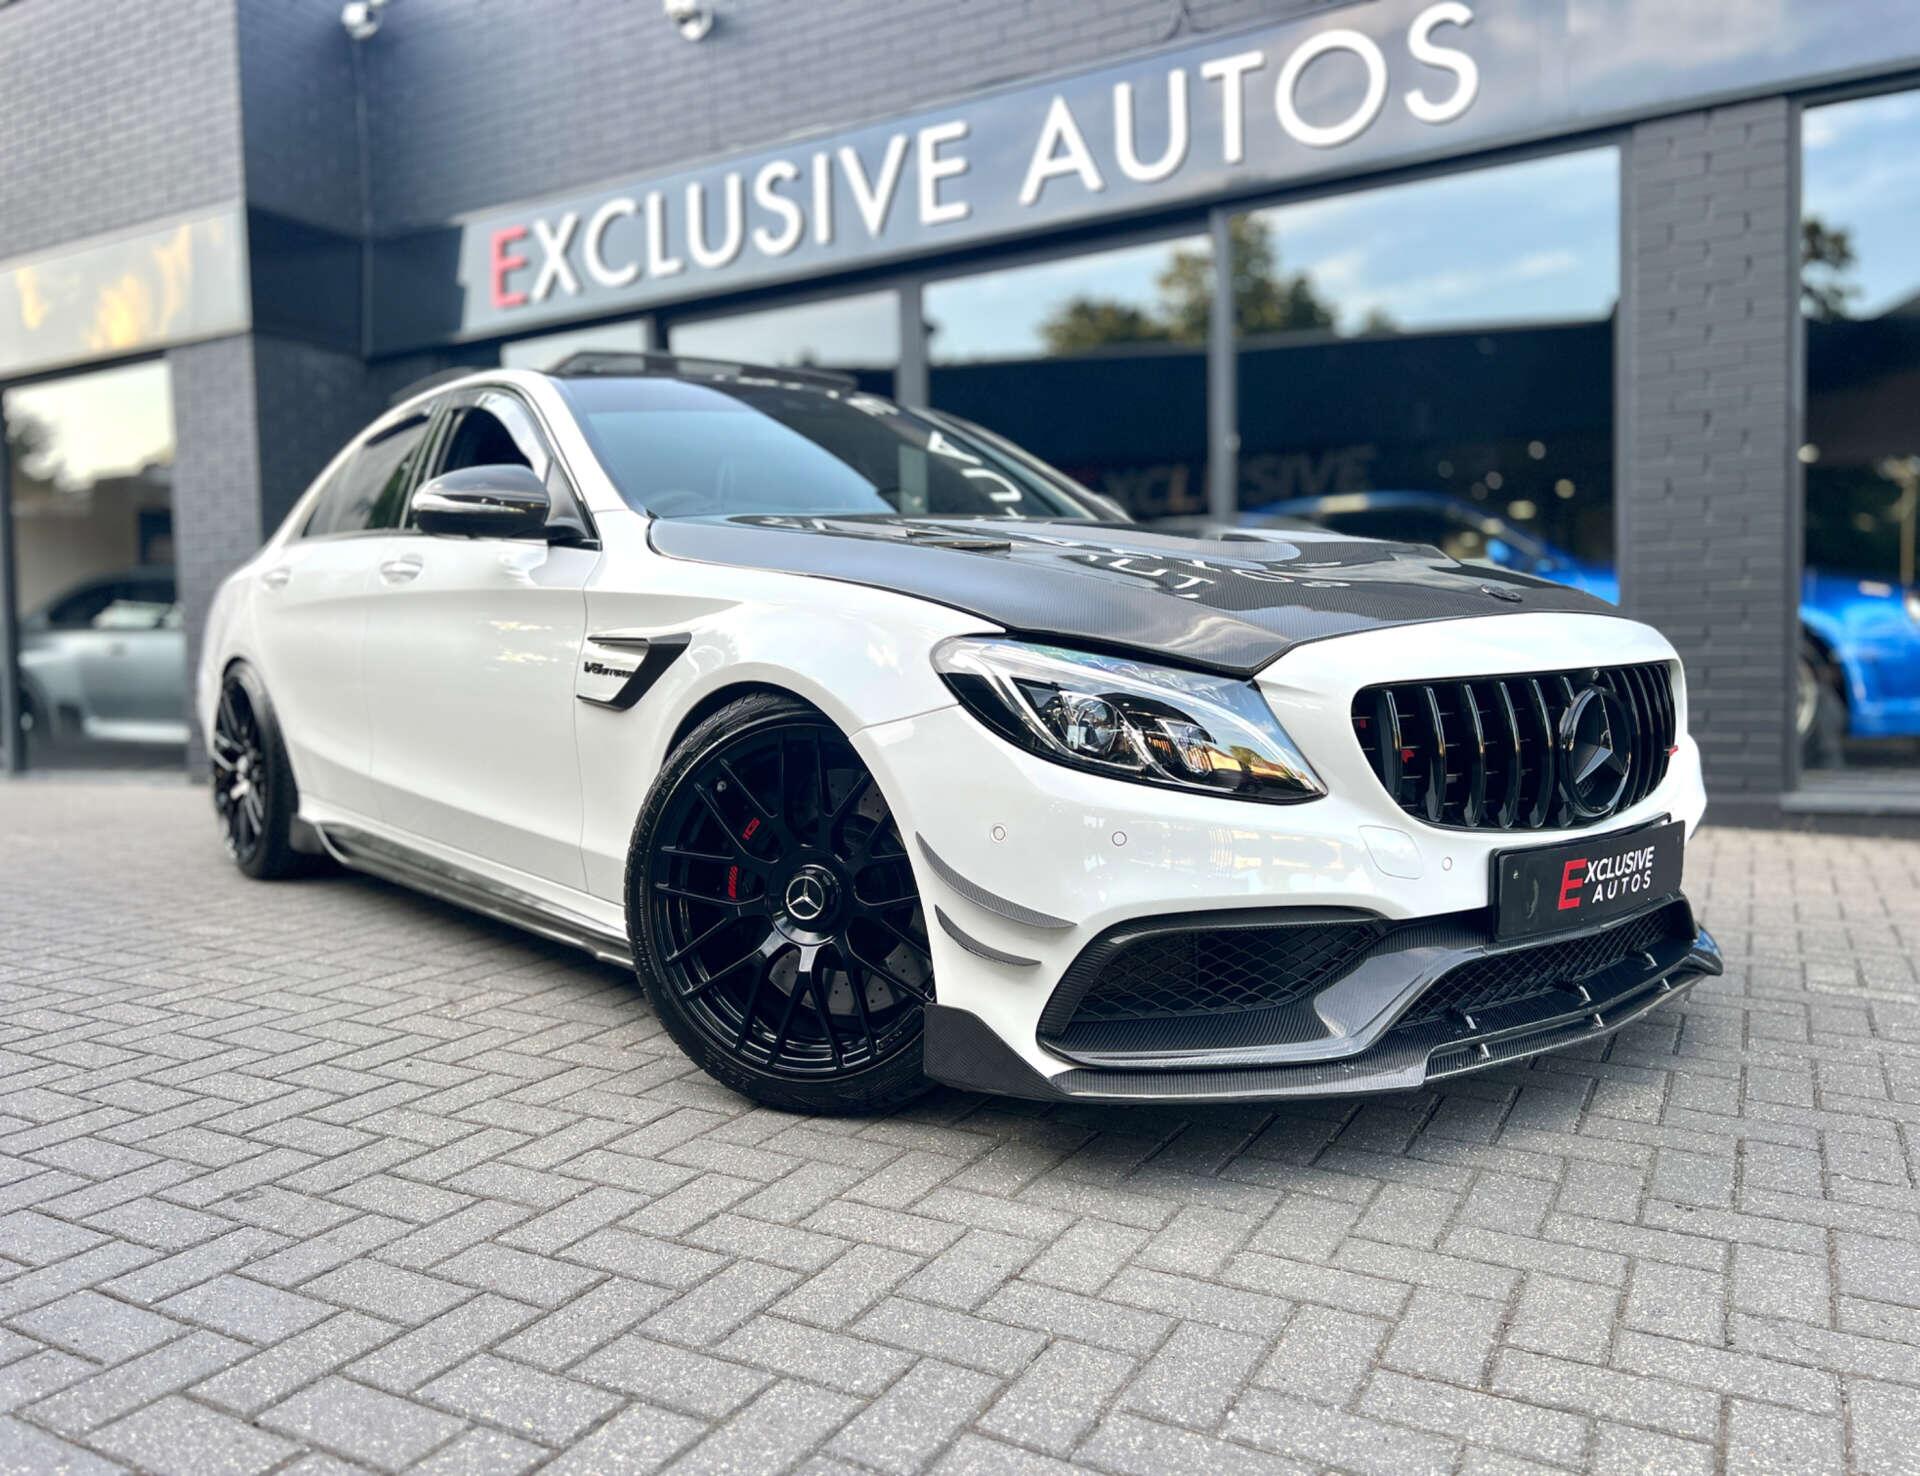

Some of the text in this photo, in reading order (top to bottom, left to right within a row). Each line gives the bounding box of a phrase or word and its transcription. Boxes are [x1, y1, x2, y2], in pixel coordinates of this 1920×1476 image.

[490, 1, 1480, 310] EXCLUSIVE AUTOS
[1558, 846, 1656, 911] EXCLUSIVE
[1592, 871, 1652, 903] AUTOS
